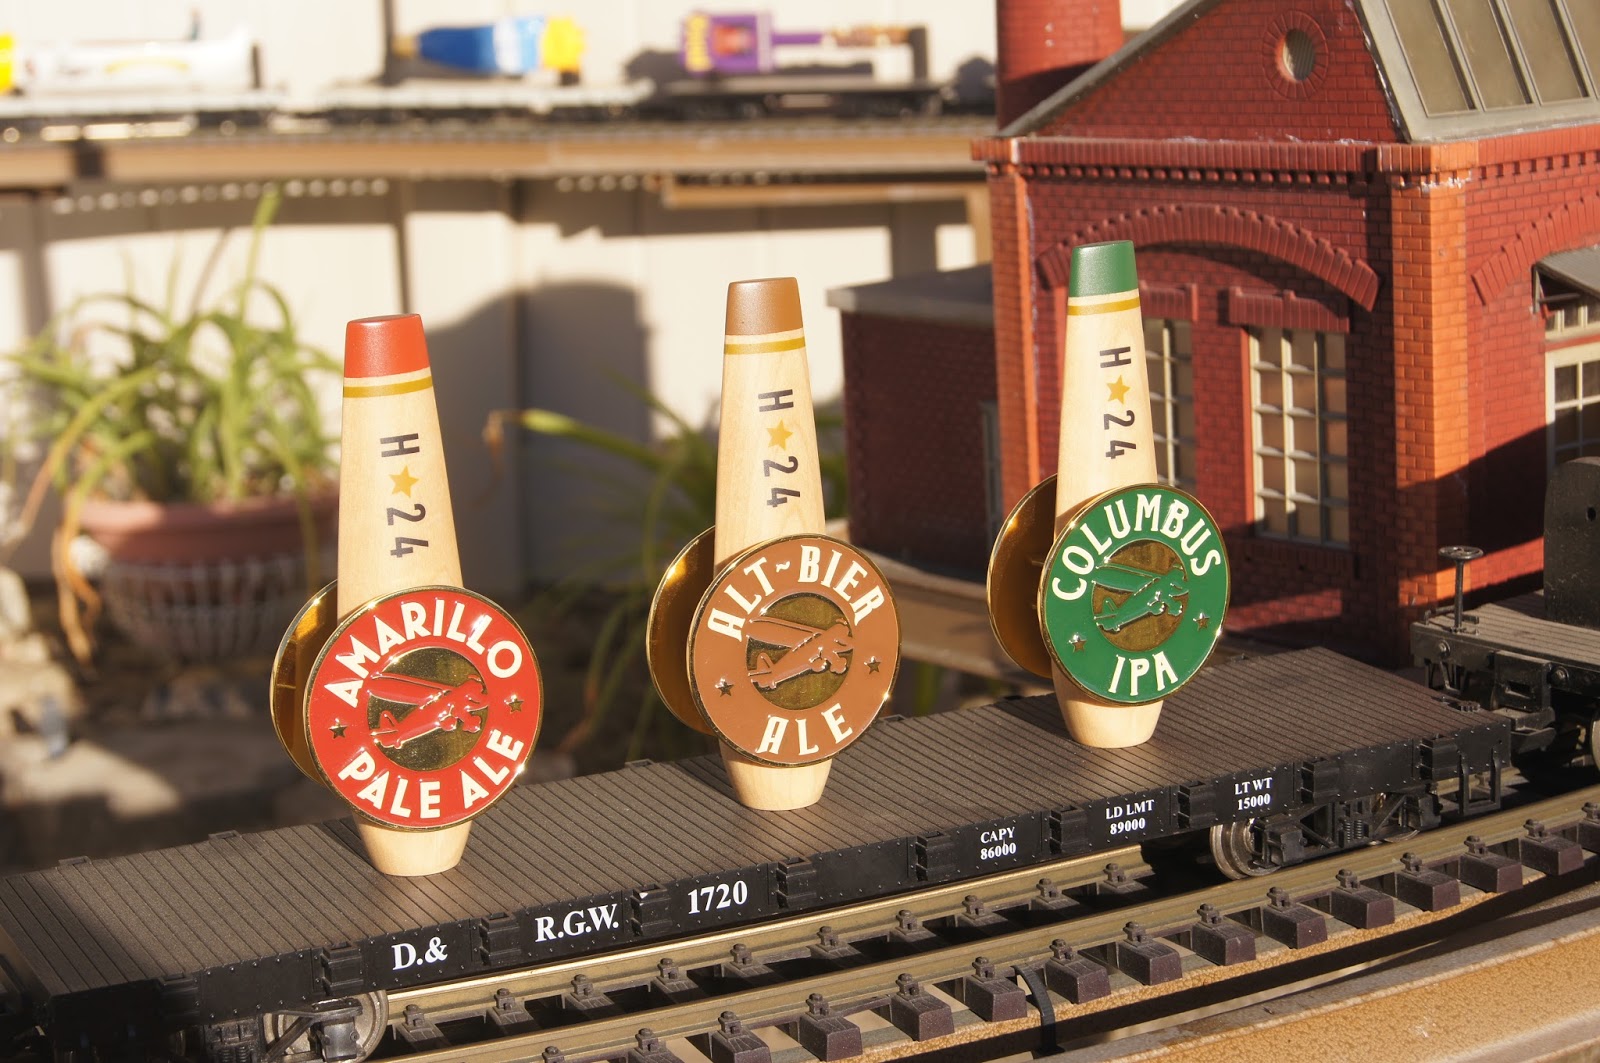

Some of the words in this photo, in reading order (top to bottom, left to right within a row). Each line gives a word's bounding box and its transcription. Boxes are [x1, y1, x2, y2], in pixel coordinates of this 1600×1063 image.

[1051, 493, 1222, 601] COLUMBUS
[324, 598, 523, 708] AMARILLO
[1108, 650, 1179, 697] IPA
[755, 703, 853, 756] ALE
[338, 749, 441, 819] PALE
[460, 729, 525, 810] ALE
[1234, 782, 1251, 796] LT
[1252, 777, 1273, 792] WT
[1105, 805, 1123, 820] LD
[1126, 799, 1155, 816] LMT
[1237, 793, 1271, 810] 15000
[980, 826, 1015, 844] CAPY
[1109, 818, 1146, 835] 89000
[980, 842, 1017, 861] 86000
[391, 936, 448, 970] D.&
[534, 904, 620, 943] R.G.W.
[687, 880, 748, 915] 1720
